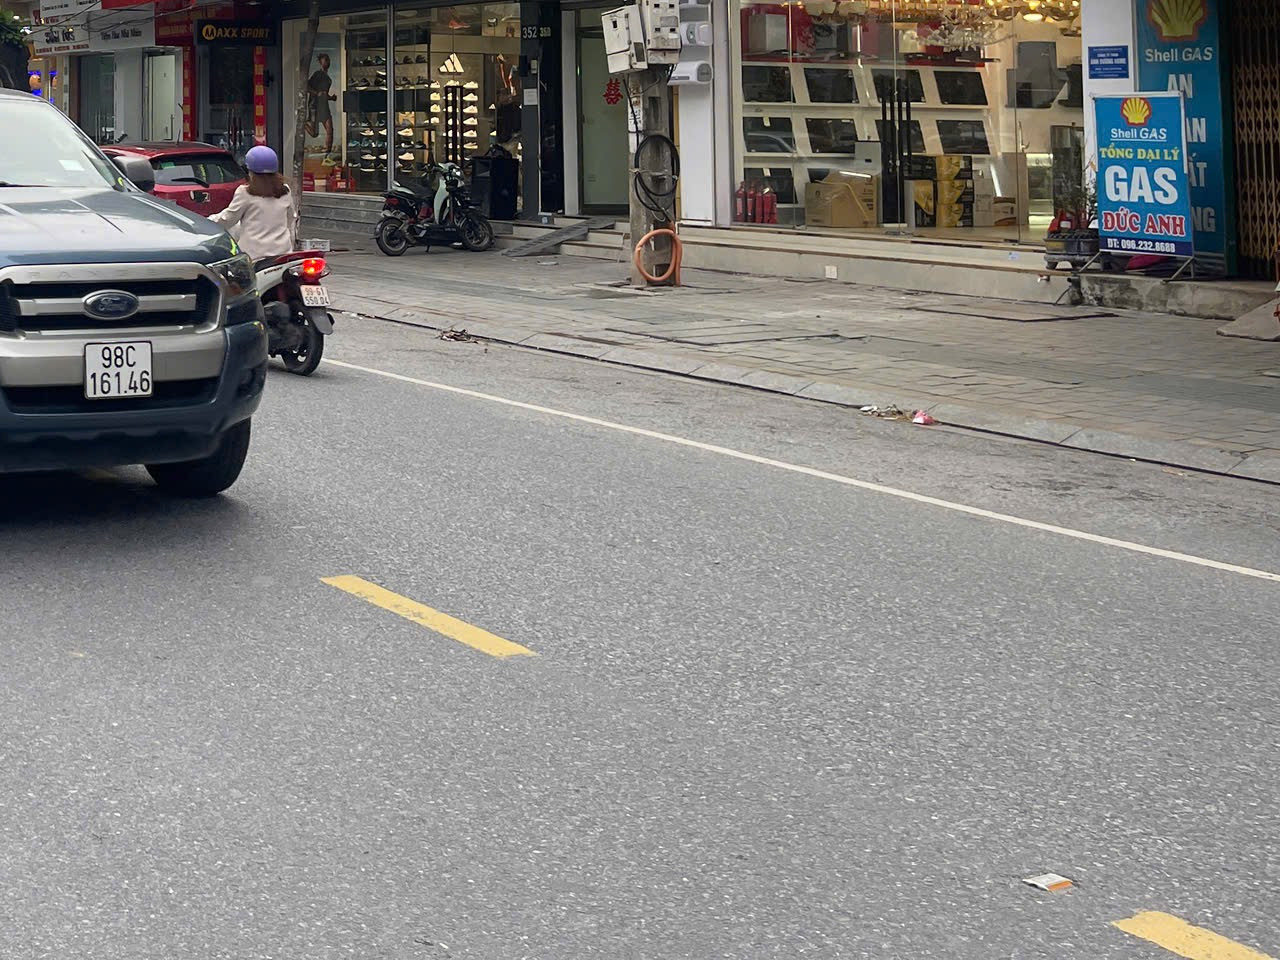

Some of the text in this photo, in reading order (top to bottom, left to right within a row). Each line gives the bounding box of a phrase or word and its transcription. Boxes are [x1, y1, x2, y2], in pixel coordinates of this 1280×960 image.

[239, 27, 270, 39] SPORT
[1145, 47, 1213, 62] Shell GAS
[1111, 127, 1167, 140] Shell GAS
[1099, 142, 1180, 163] TỔNG ĐẠI LÝ
[1104, 165, 1179, 205] GAS
[1102, 206, 1186, 237] ĐỨC ANH
[101, 345, 136, 368] 98C
[90, 369, 150, 395] 161.46
